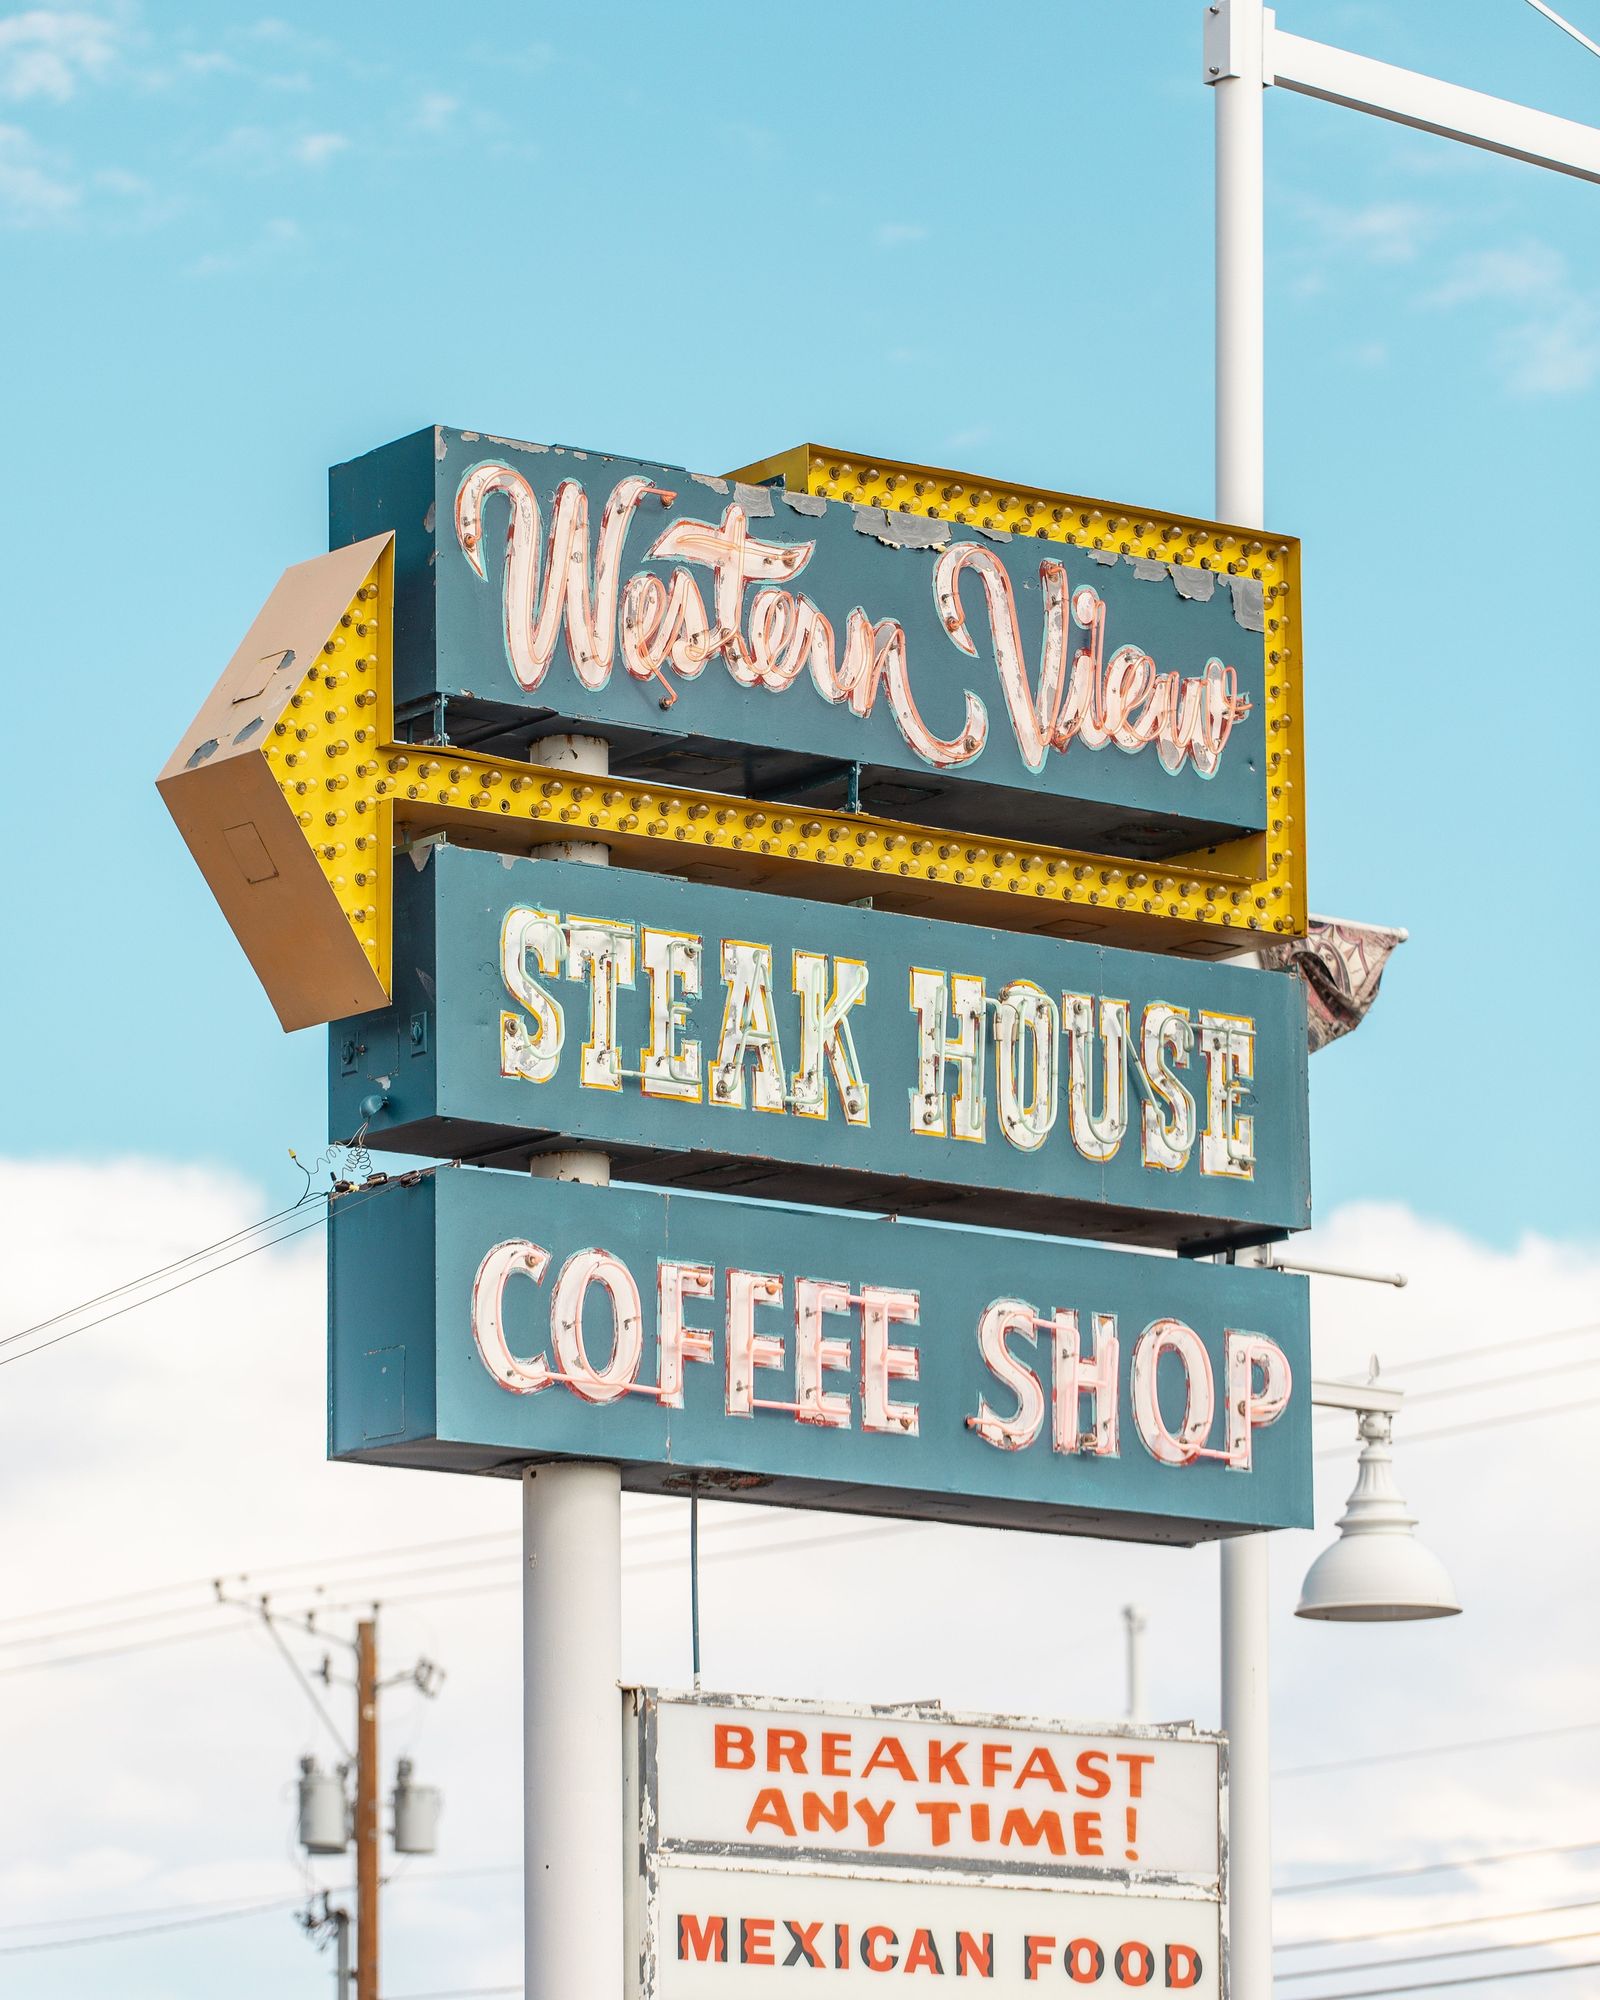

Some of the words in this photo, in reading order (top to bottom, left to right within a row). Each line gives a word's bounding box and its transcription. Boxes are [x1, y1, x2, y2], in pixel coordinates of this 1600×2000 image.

[454, 460, 988, 769] Western
[931, 540, 1254, 779] View
[499, 904, 872, 1127] STEAK
[907, 967, 1257, 1181] HOUSE
[471, 1238, 921, 1434] COFFEE
[965, 1297, 1294, 1472] SHOP
[714, 1723, 1155, 1799] BREAKFAST
[745, 1788, 896, 1847] ANY
[916, 1802, 1138, 1861] TIME!
[677, 1914, 994, 1978] MEXICAN
[1023, 1935, 1203, 1988] FOOD
